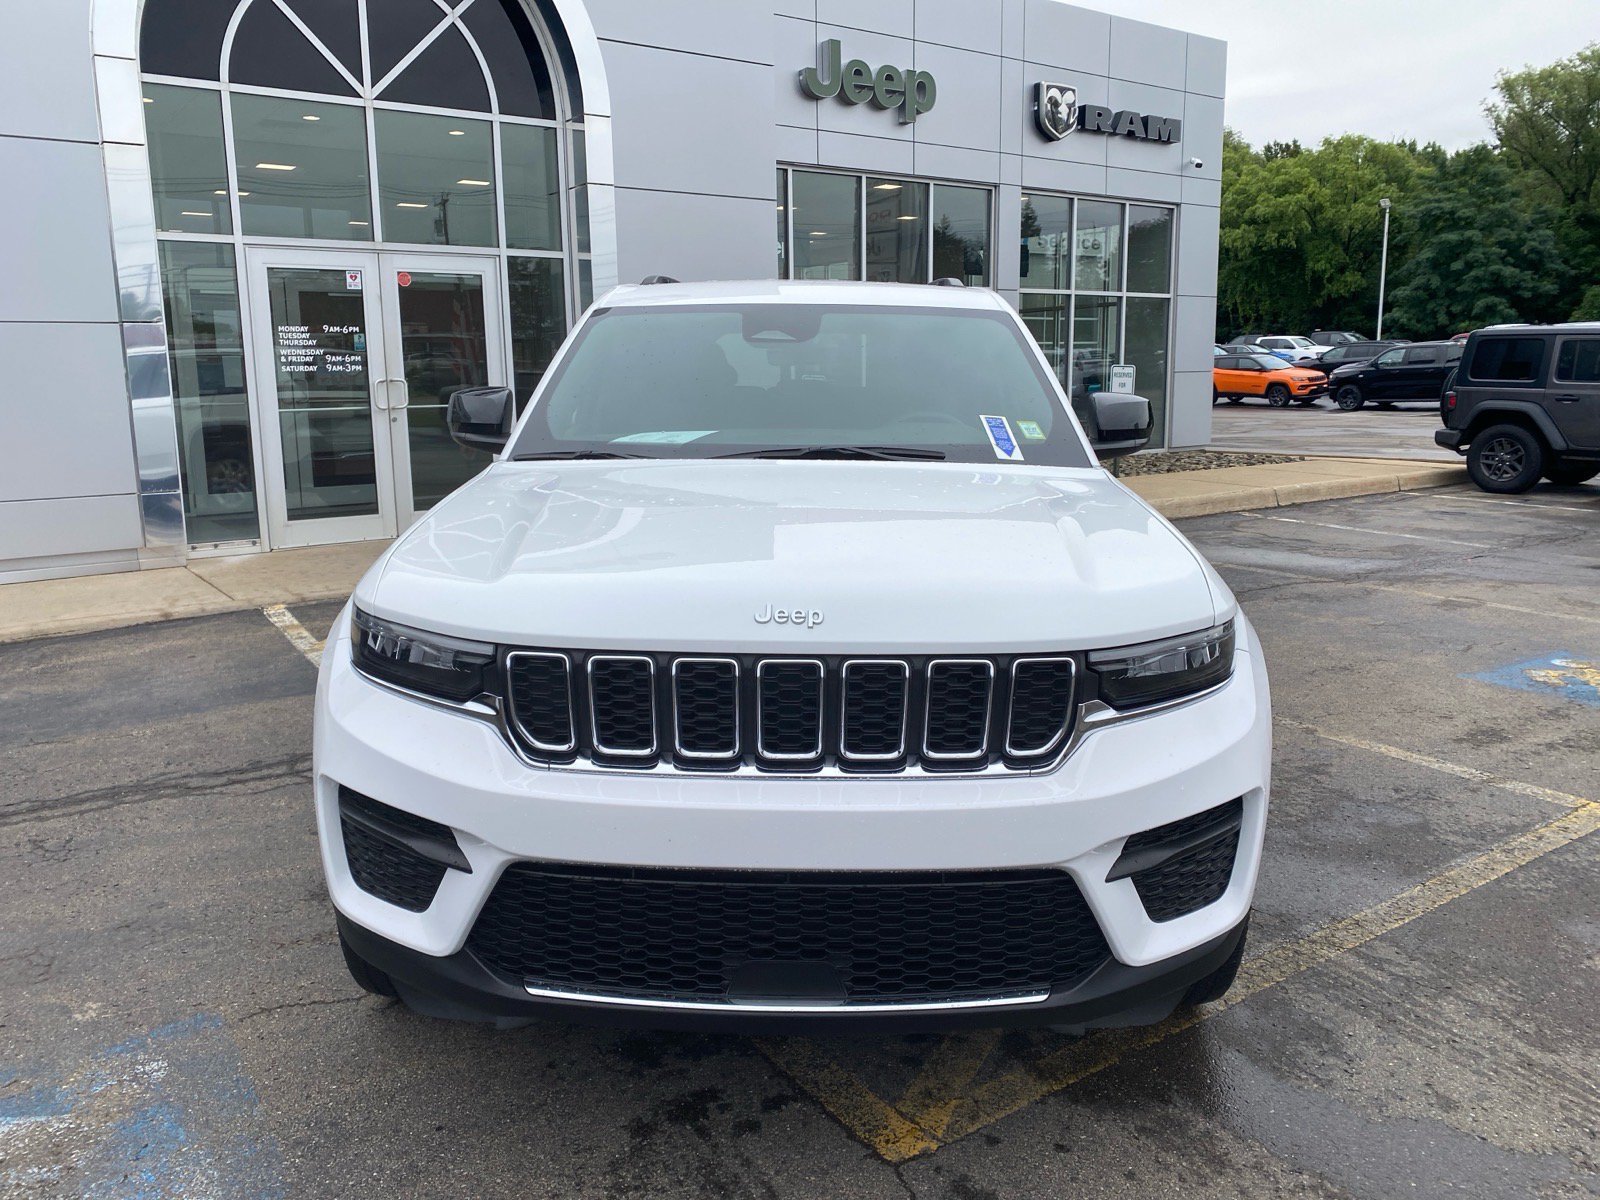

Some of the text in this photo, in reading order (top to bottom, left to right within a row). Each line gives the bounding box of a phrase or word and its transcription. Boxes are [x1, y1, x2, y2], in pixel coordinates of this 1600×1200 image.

[799, 38, 936, 125] Jeep
[1079, 104, 1181, 145] RAM
[322, 324, 360, 334] 9AM-6PM
[325, 354, 362, 363] 9AM-6PM
[326, 363, 362, 372] 9AM-3PM
[754, 602, 824, 629] Jeep
